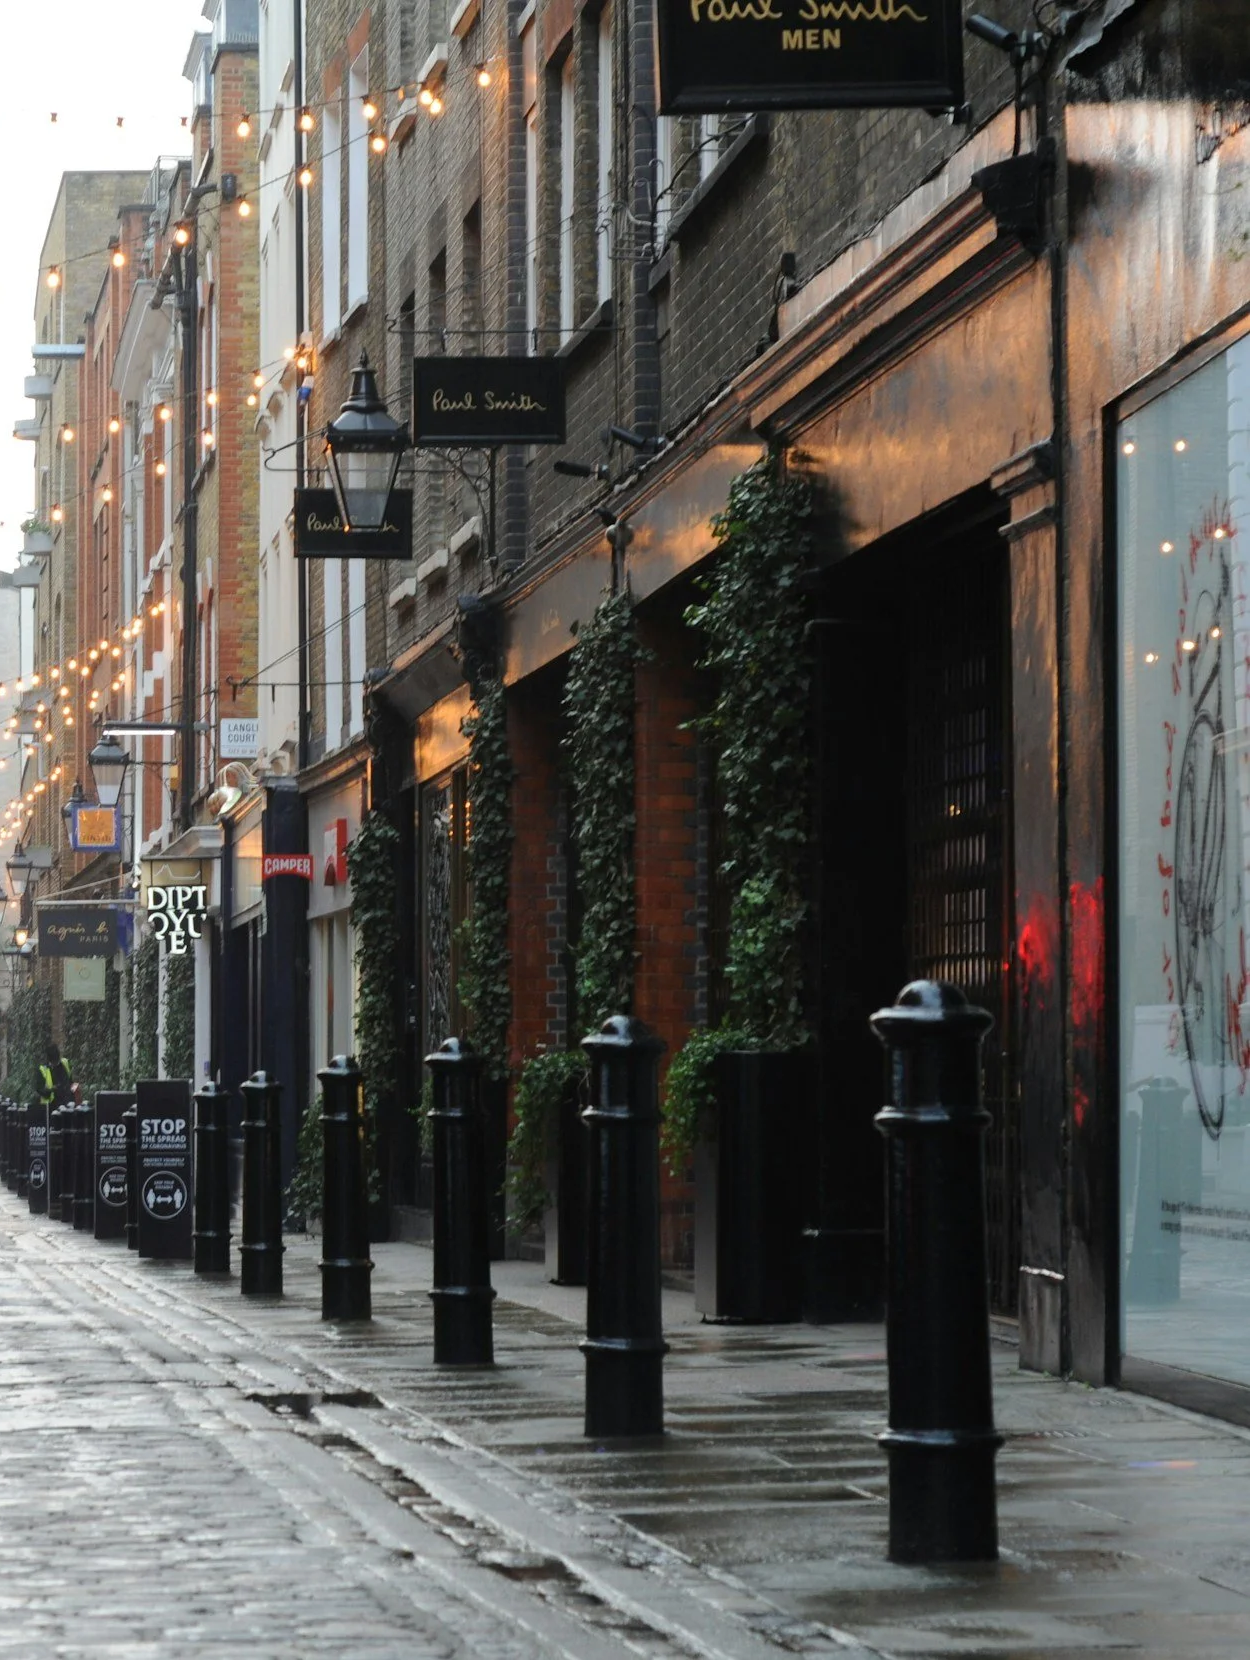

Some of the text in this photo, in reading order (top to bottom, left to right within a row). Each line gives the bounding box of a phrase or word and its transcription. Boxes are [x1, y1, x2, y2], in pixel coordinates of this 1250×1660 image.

[689, 0, 928, 22] Paul Smith
[782, 29, 841, 49] MEN
[433, 388, 546, 412] Paul Smith
[307, 512, 341, 532] Paul
[228, 733, 255, 743] COURT
[264, 857, 311, 876] CAMPER
[147, 886, 207, 910] DIPT
[168, 931, 187, 954] E
[30, 1127, 46, 1136] STOP
[141, 1118, 186, 1135] STOP
[142, 1135, 186, 1143] THE SPREAD
